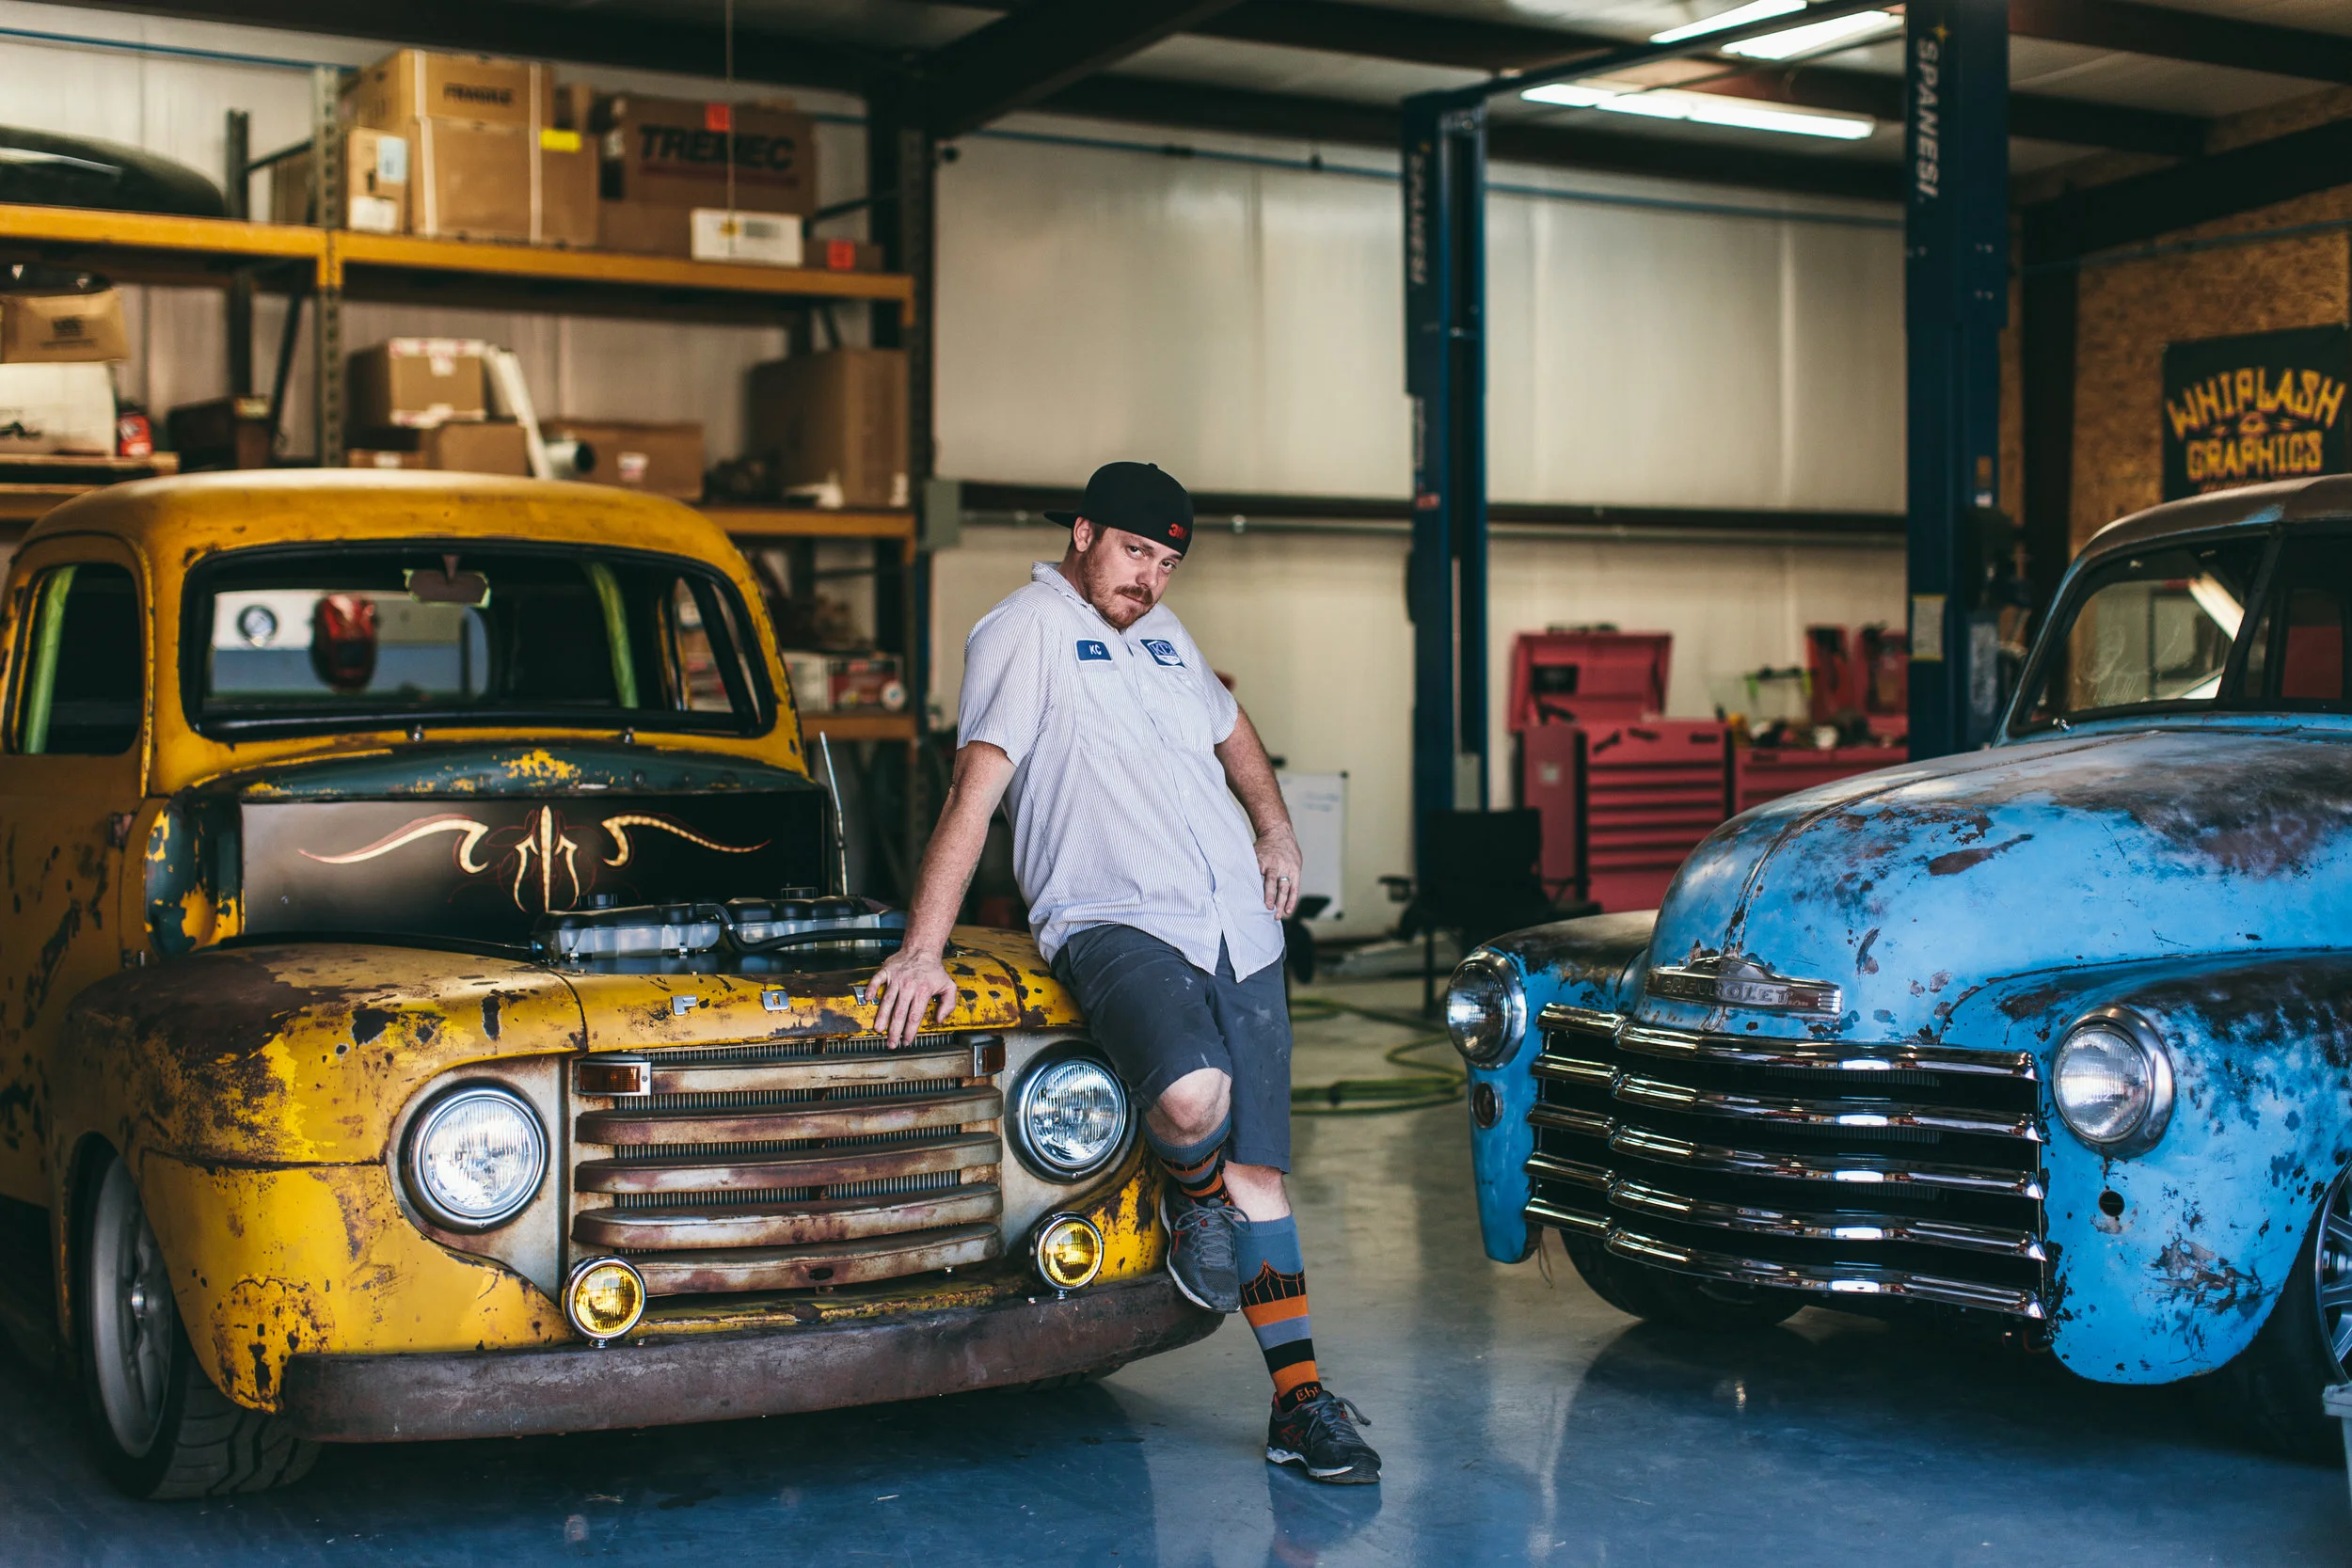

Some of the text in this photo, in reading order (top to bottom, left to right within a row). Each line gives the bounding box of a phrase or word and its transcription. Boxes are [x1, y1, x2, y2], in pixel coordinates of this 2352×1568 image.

[1916, 38, 1940, 198] SPANESI
[2166, 366, 2346, 443] WHIPLASH
[2186, 430, 2323, 483] GRAPHICS
[1089, 644, 1102, 656] KC
[1661, 977, 1793, 1006] CHEVROLET
